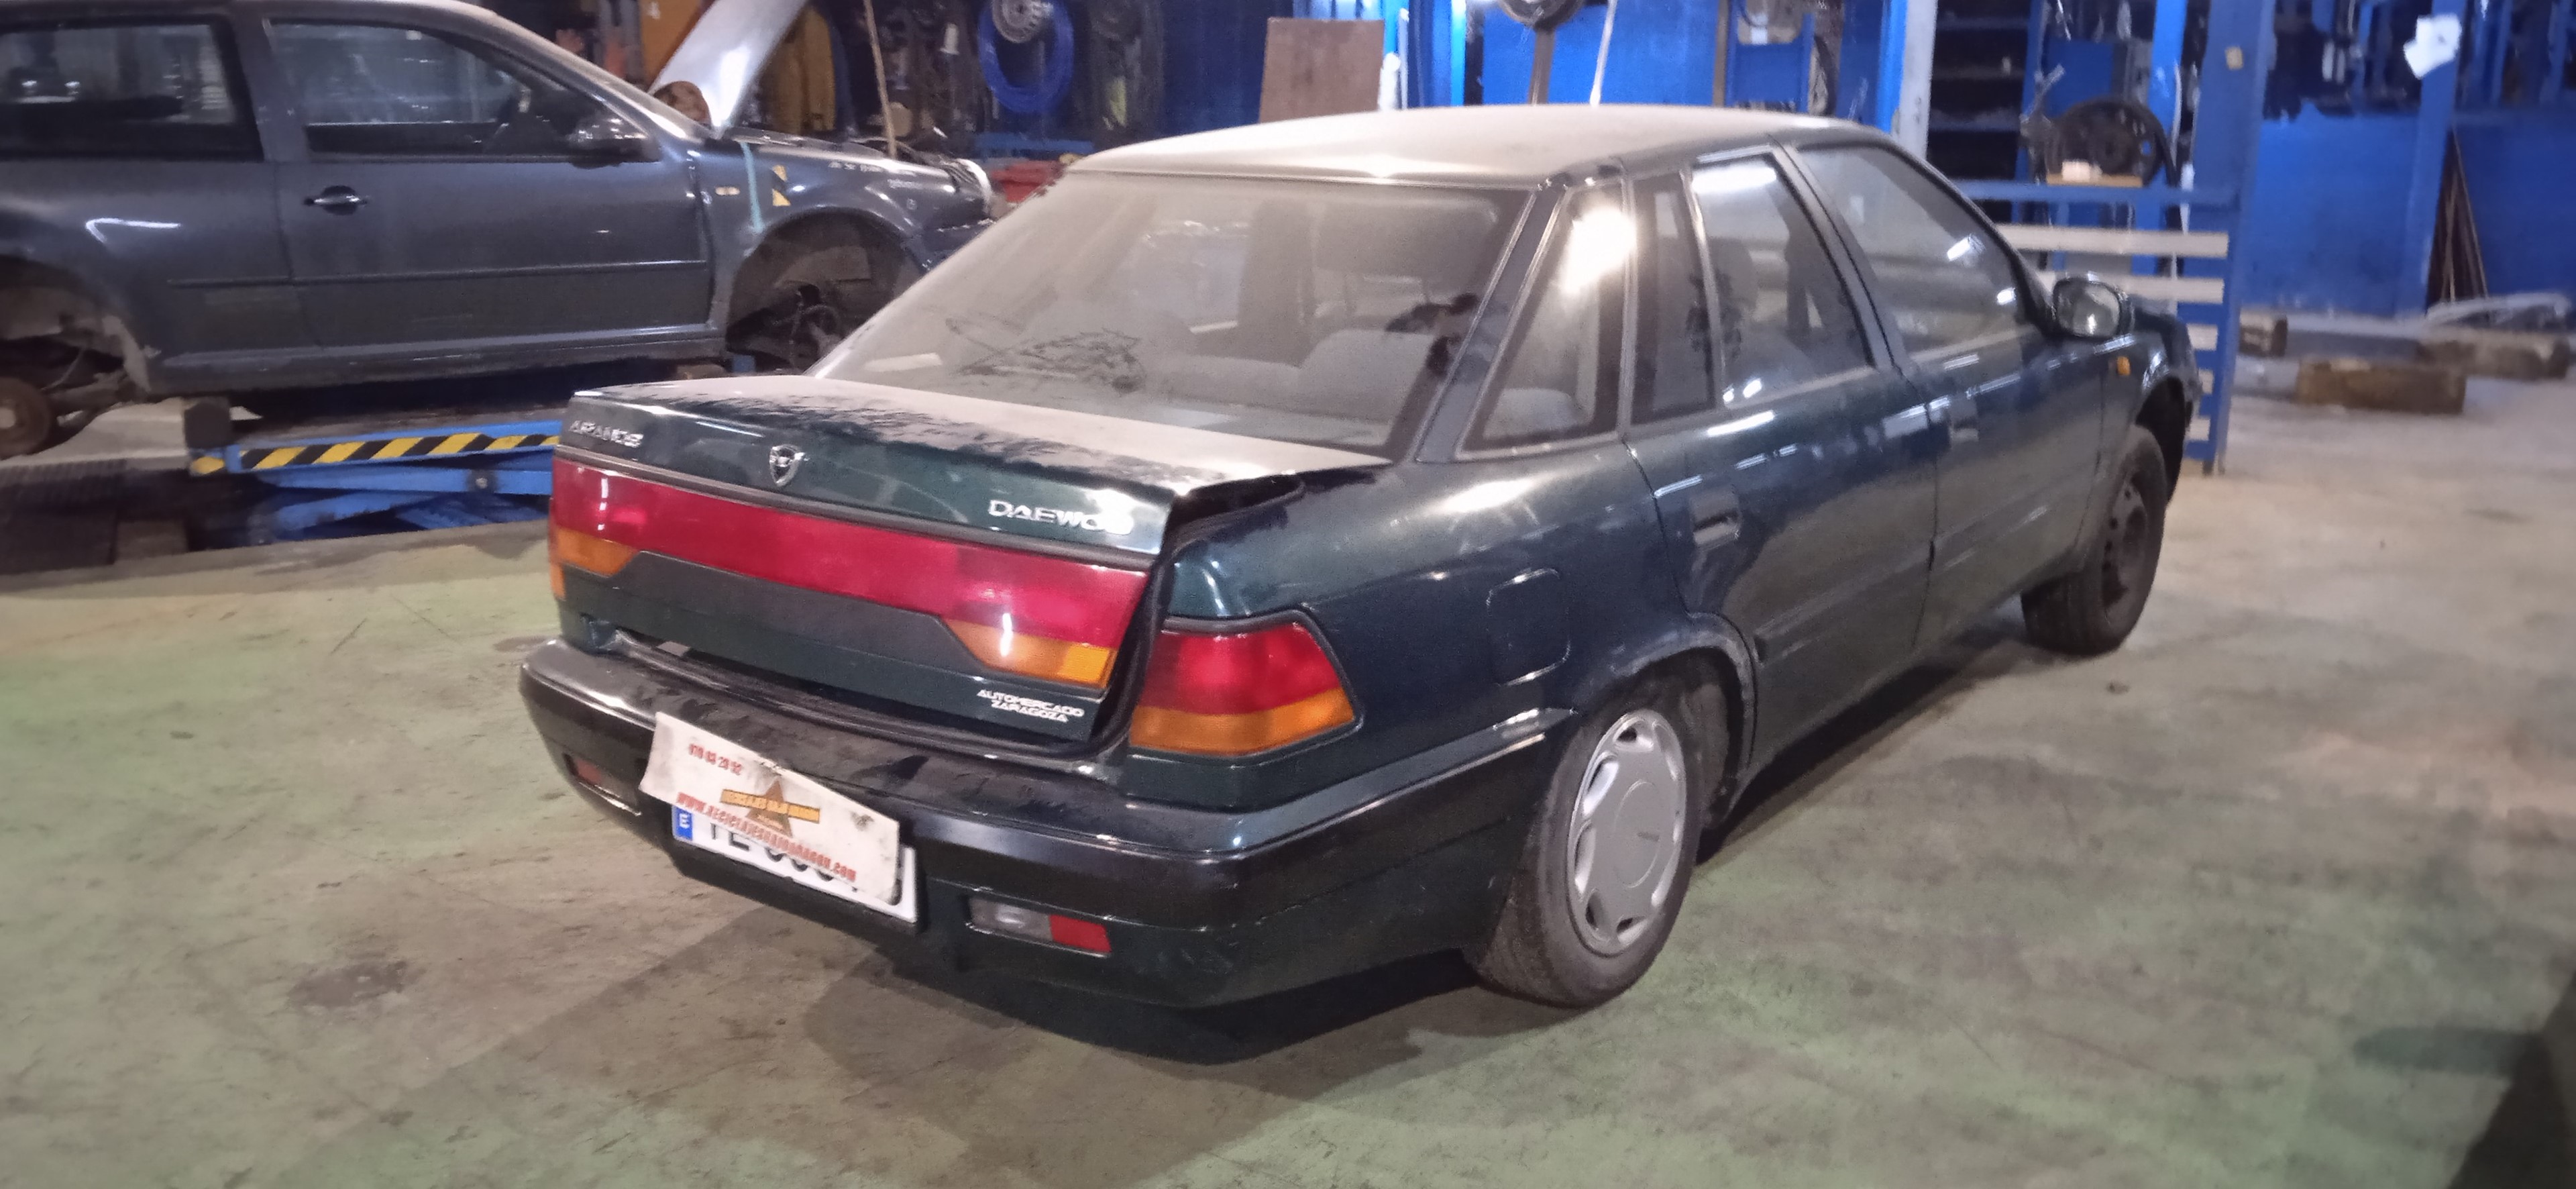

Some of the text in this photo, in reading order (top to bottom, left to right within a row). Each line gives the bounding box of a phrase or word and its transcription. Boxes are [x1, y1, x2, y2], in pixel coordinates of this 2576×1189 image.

[977, 689, 1085, 717] AUTOMERCADO
[991, 699, 1069, 723] ZARAGOZA
[679, 812, 691, 829] E
